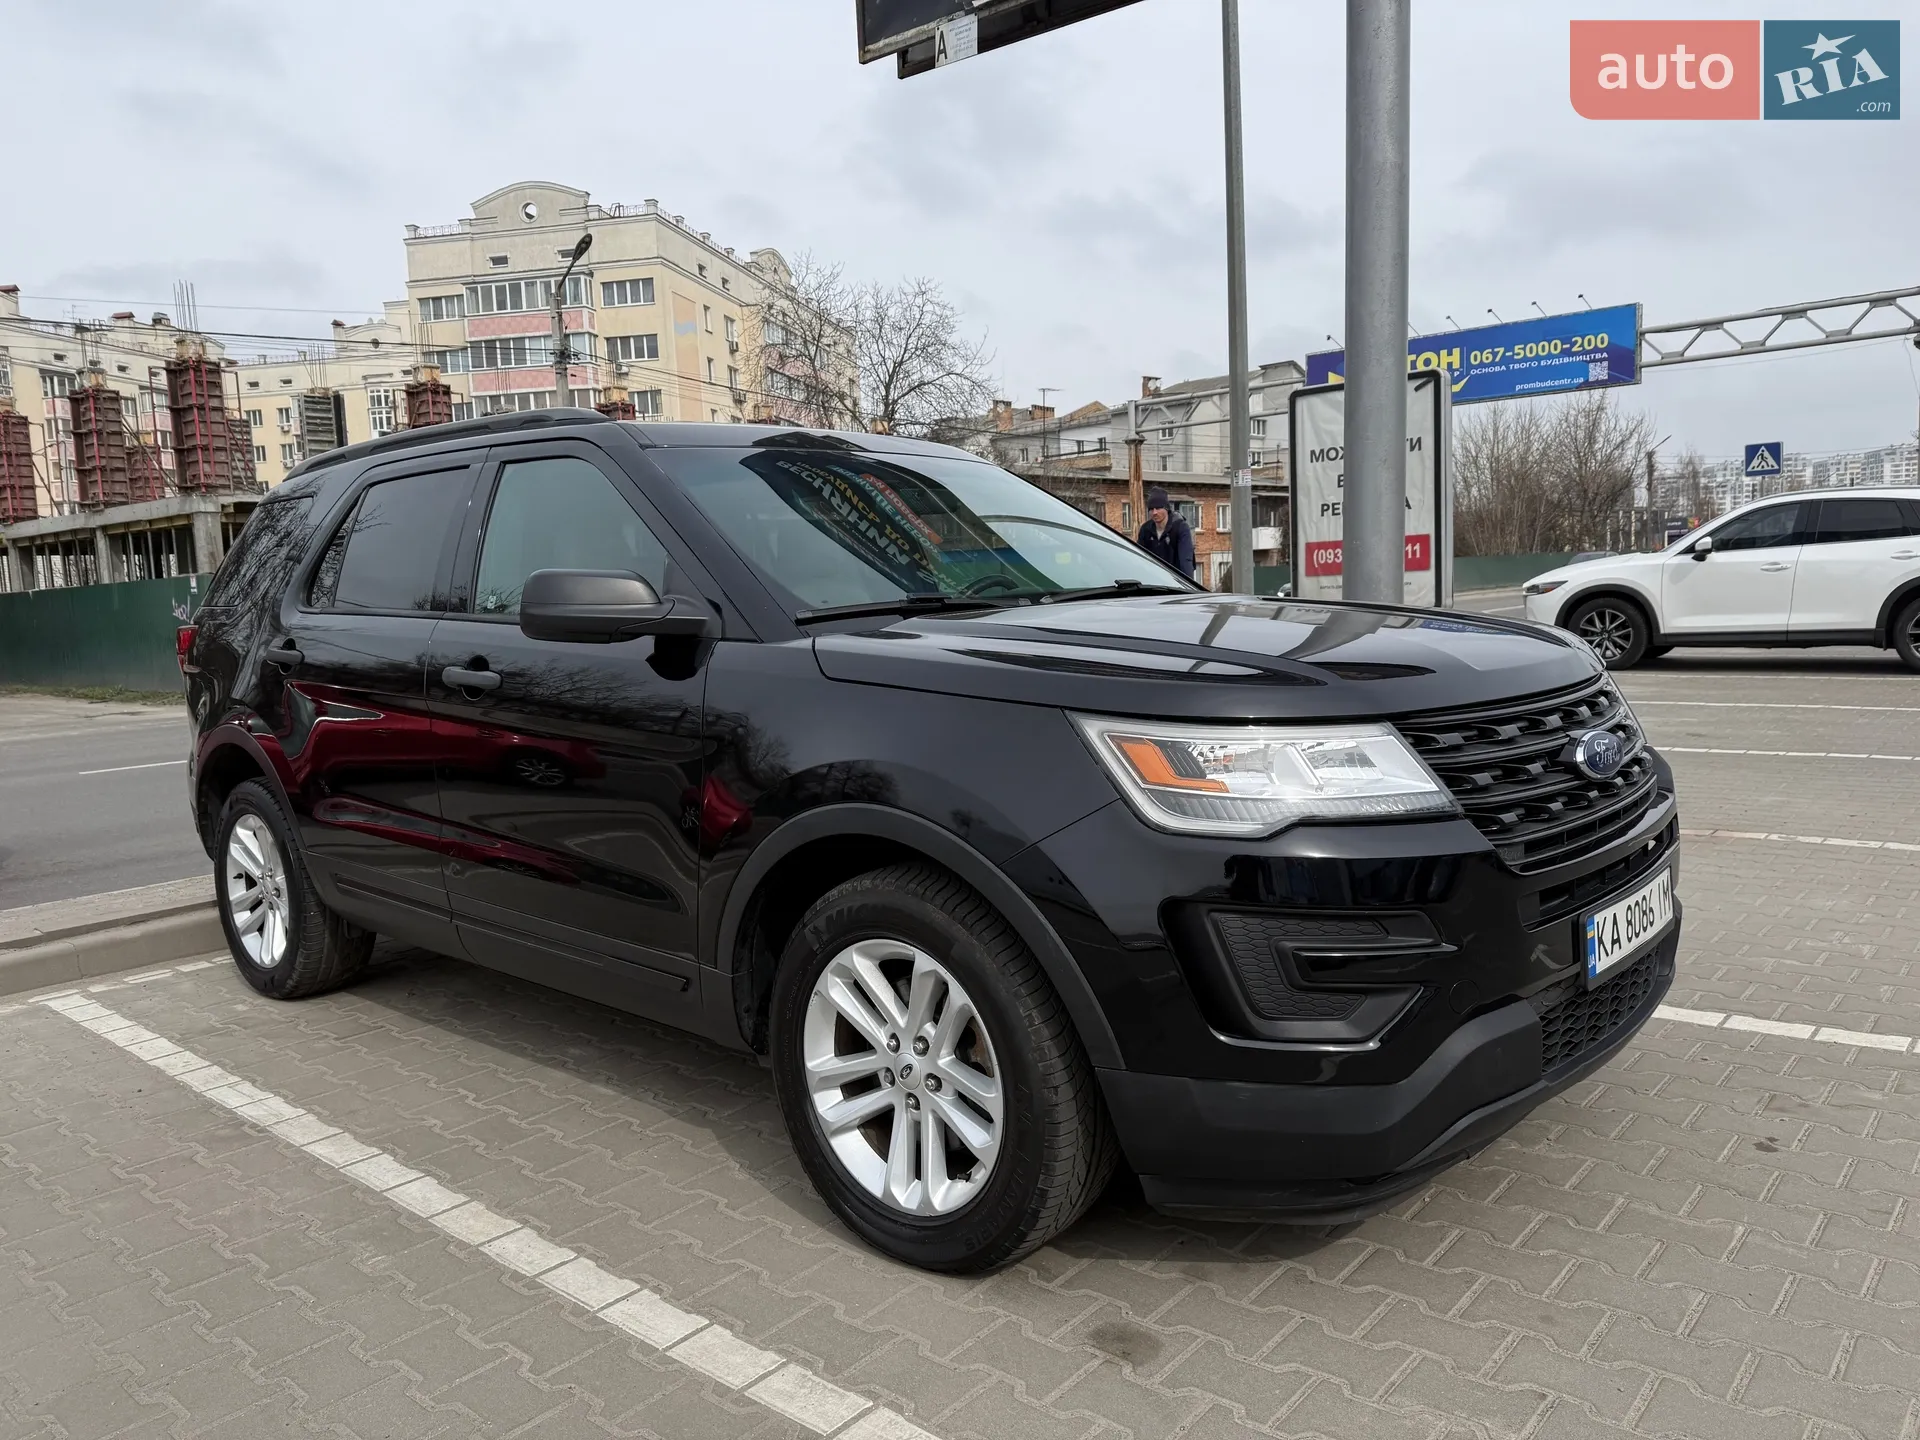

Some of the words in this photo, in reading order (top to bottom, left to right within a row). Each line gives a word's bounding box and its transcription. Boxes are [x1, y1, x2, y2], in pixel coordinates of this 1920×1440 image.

[1469, 332, 1610, 366] 067-5000-200
[1470, 365, 1507, 376] ОСНОВА
[1509, 360, 1539, 371] ТВОГО
[1540, 351, 1609, 367] БУДІВНИЦТВА
[1515, 376, 1585, 392] prombudcentr.ua
[1594, 738, 1621, 768] Ford
[1597, 912, 1622, 962] KA
[1625, 888, 1655, 943] 8086
